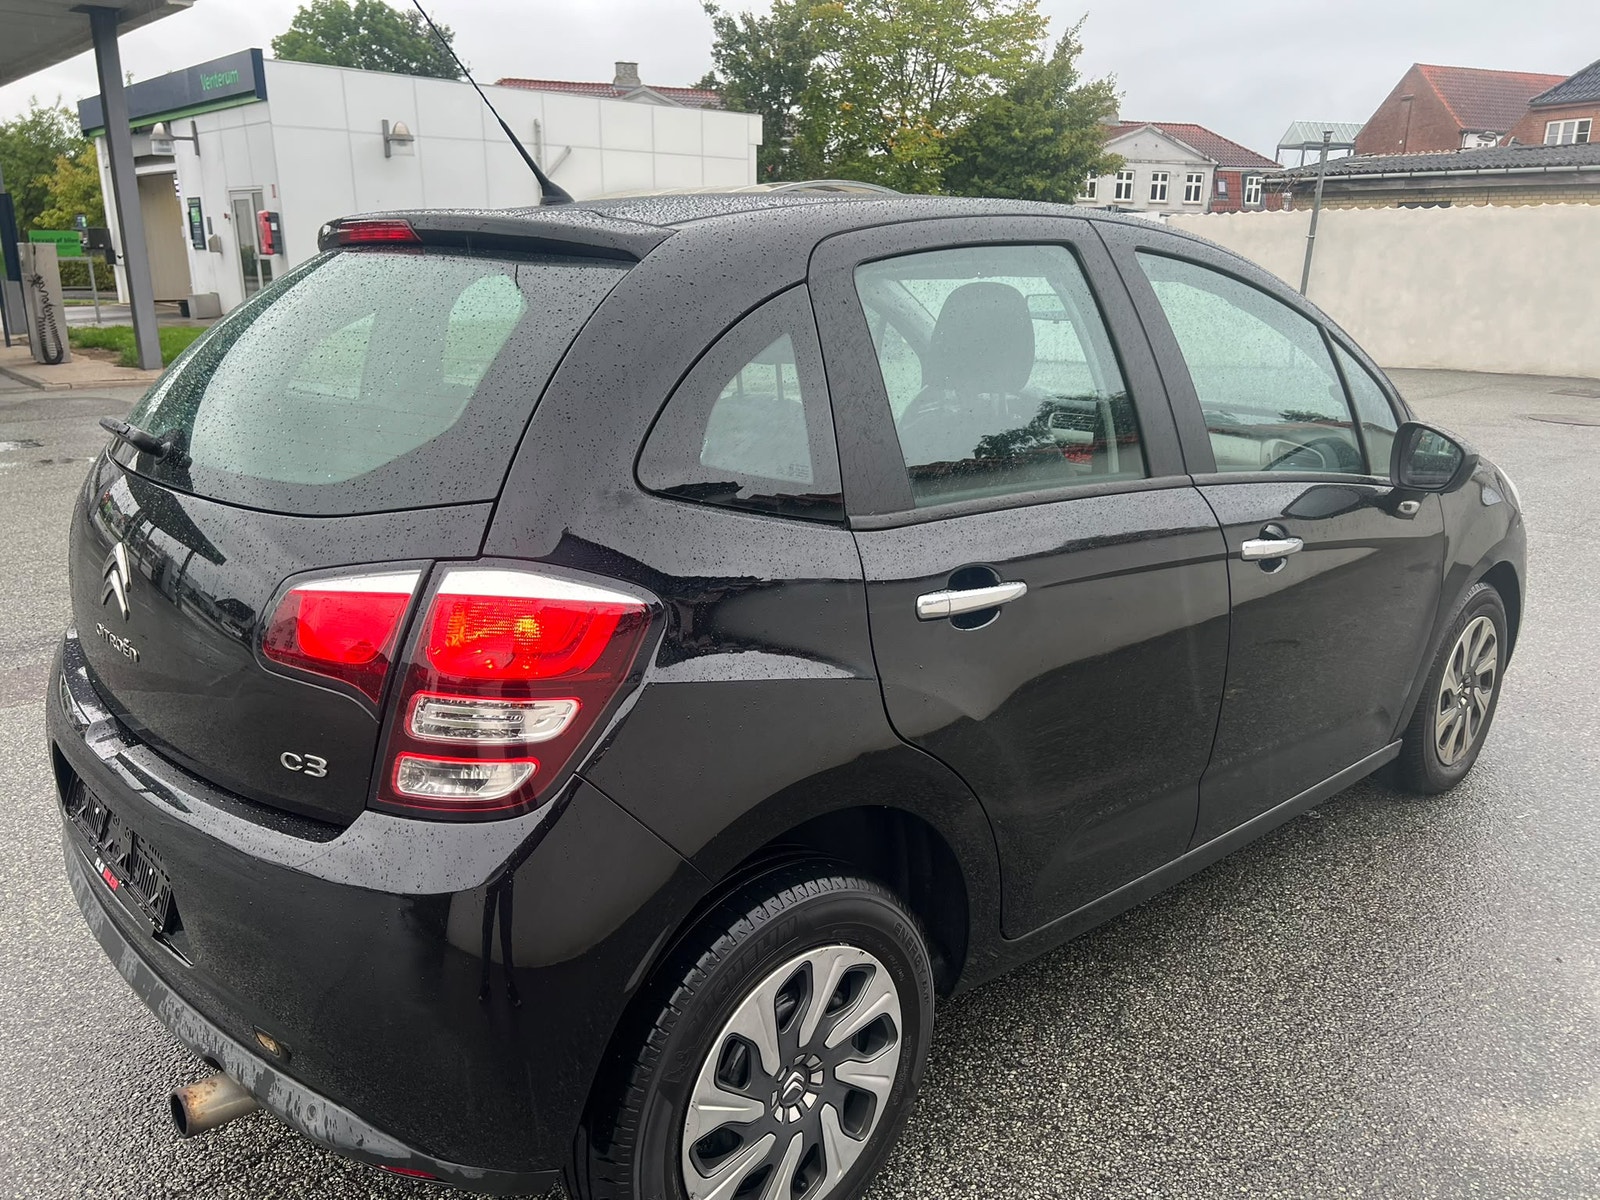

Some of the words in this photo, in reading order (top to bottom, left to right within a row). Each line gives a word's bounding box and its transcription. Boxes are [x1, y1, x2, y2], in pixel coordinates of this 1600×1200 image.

[200, 70, 239, 91] Venterum
[280, 751, 328, 778] C3
[893, 921, 926, 974] ENERGY
